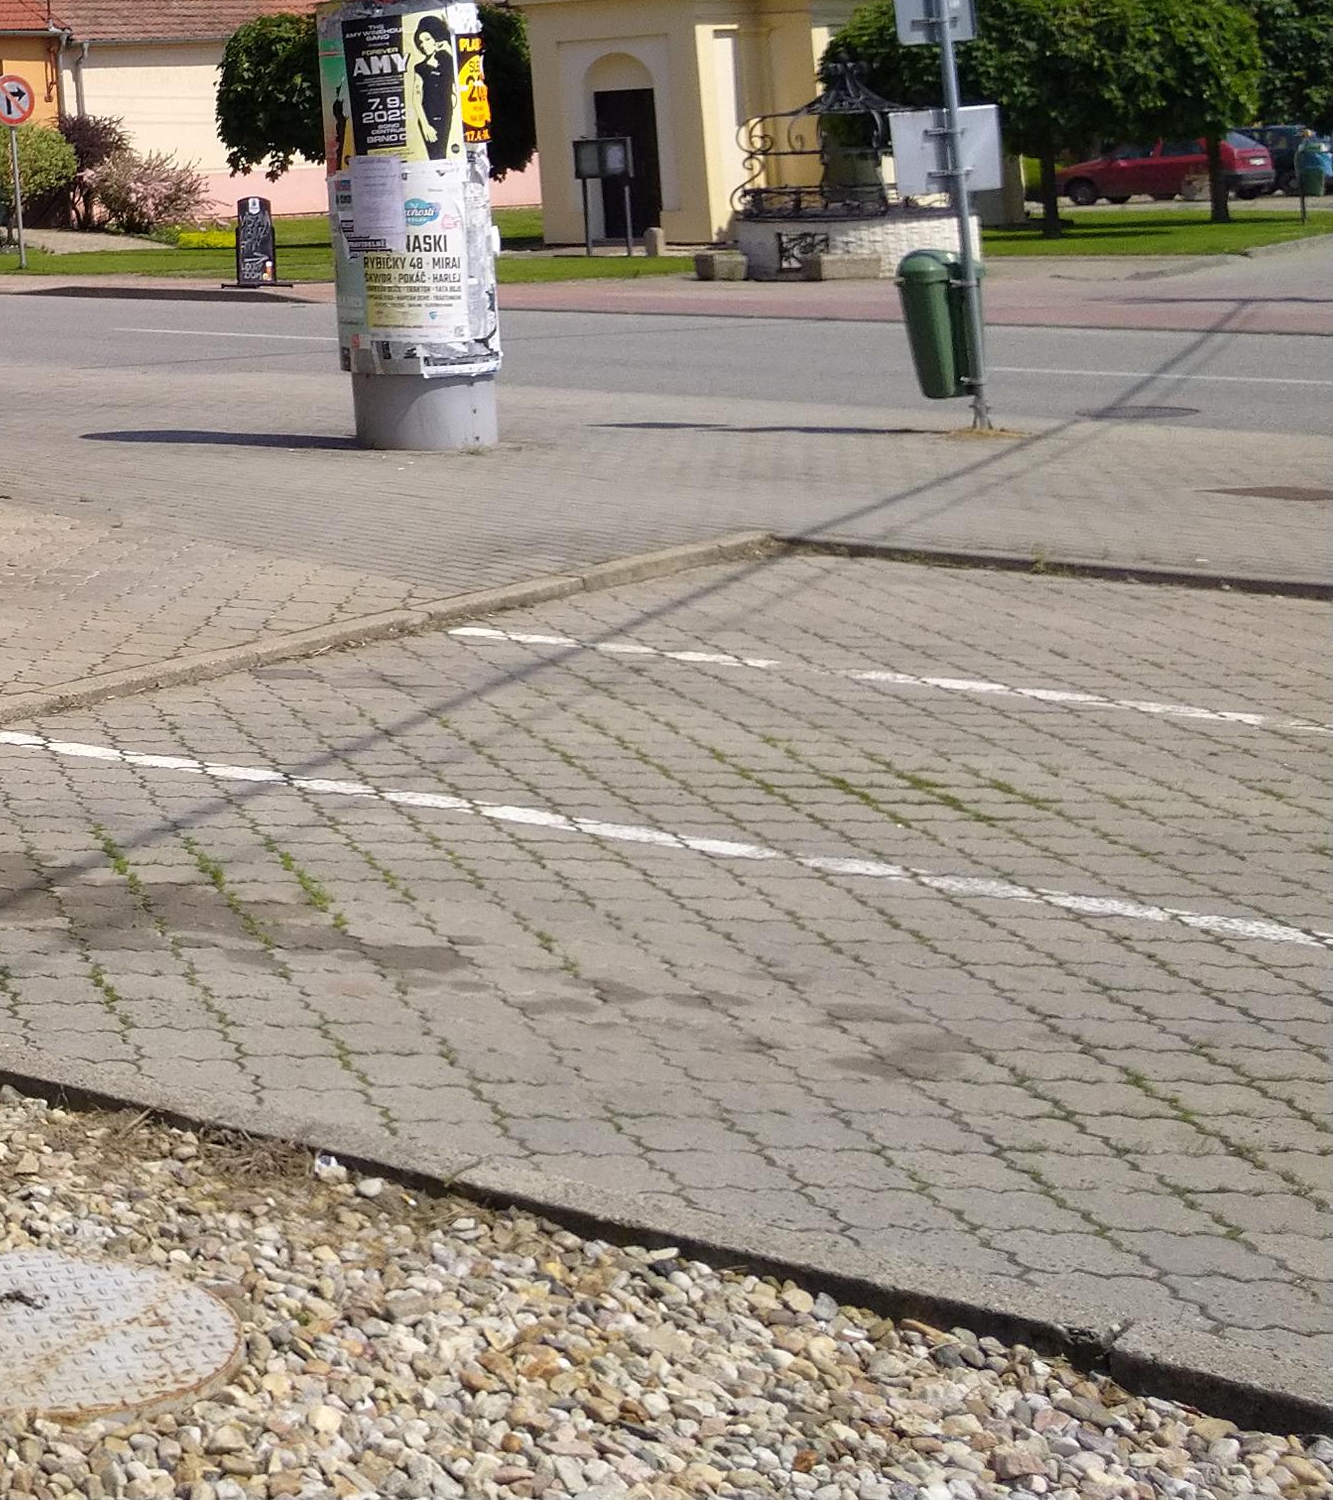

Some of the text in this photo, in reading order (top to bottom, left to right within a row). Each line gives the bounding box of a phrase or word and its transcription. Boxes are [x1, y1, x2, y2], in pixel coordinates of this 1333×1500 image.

[353, 53, 410, 77] AMY
[364, 254, 460, 269] RYBIČKY 48 MIRAI
[398, 271, 426, 283] POKÁČ
[433, 273, 460, 282] HARLEJ
